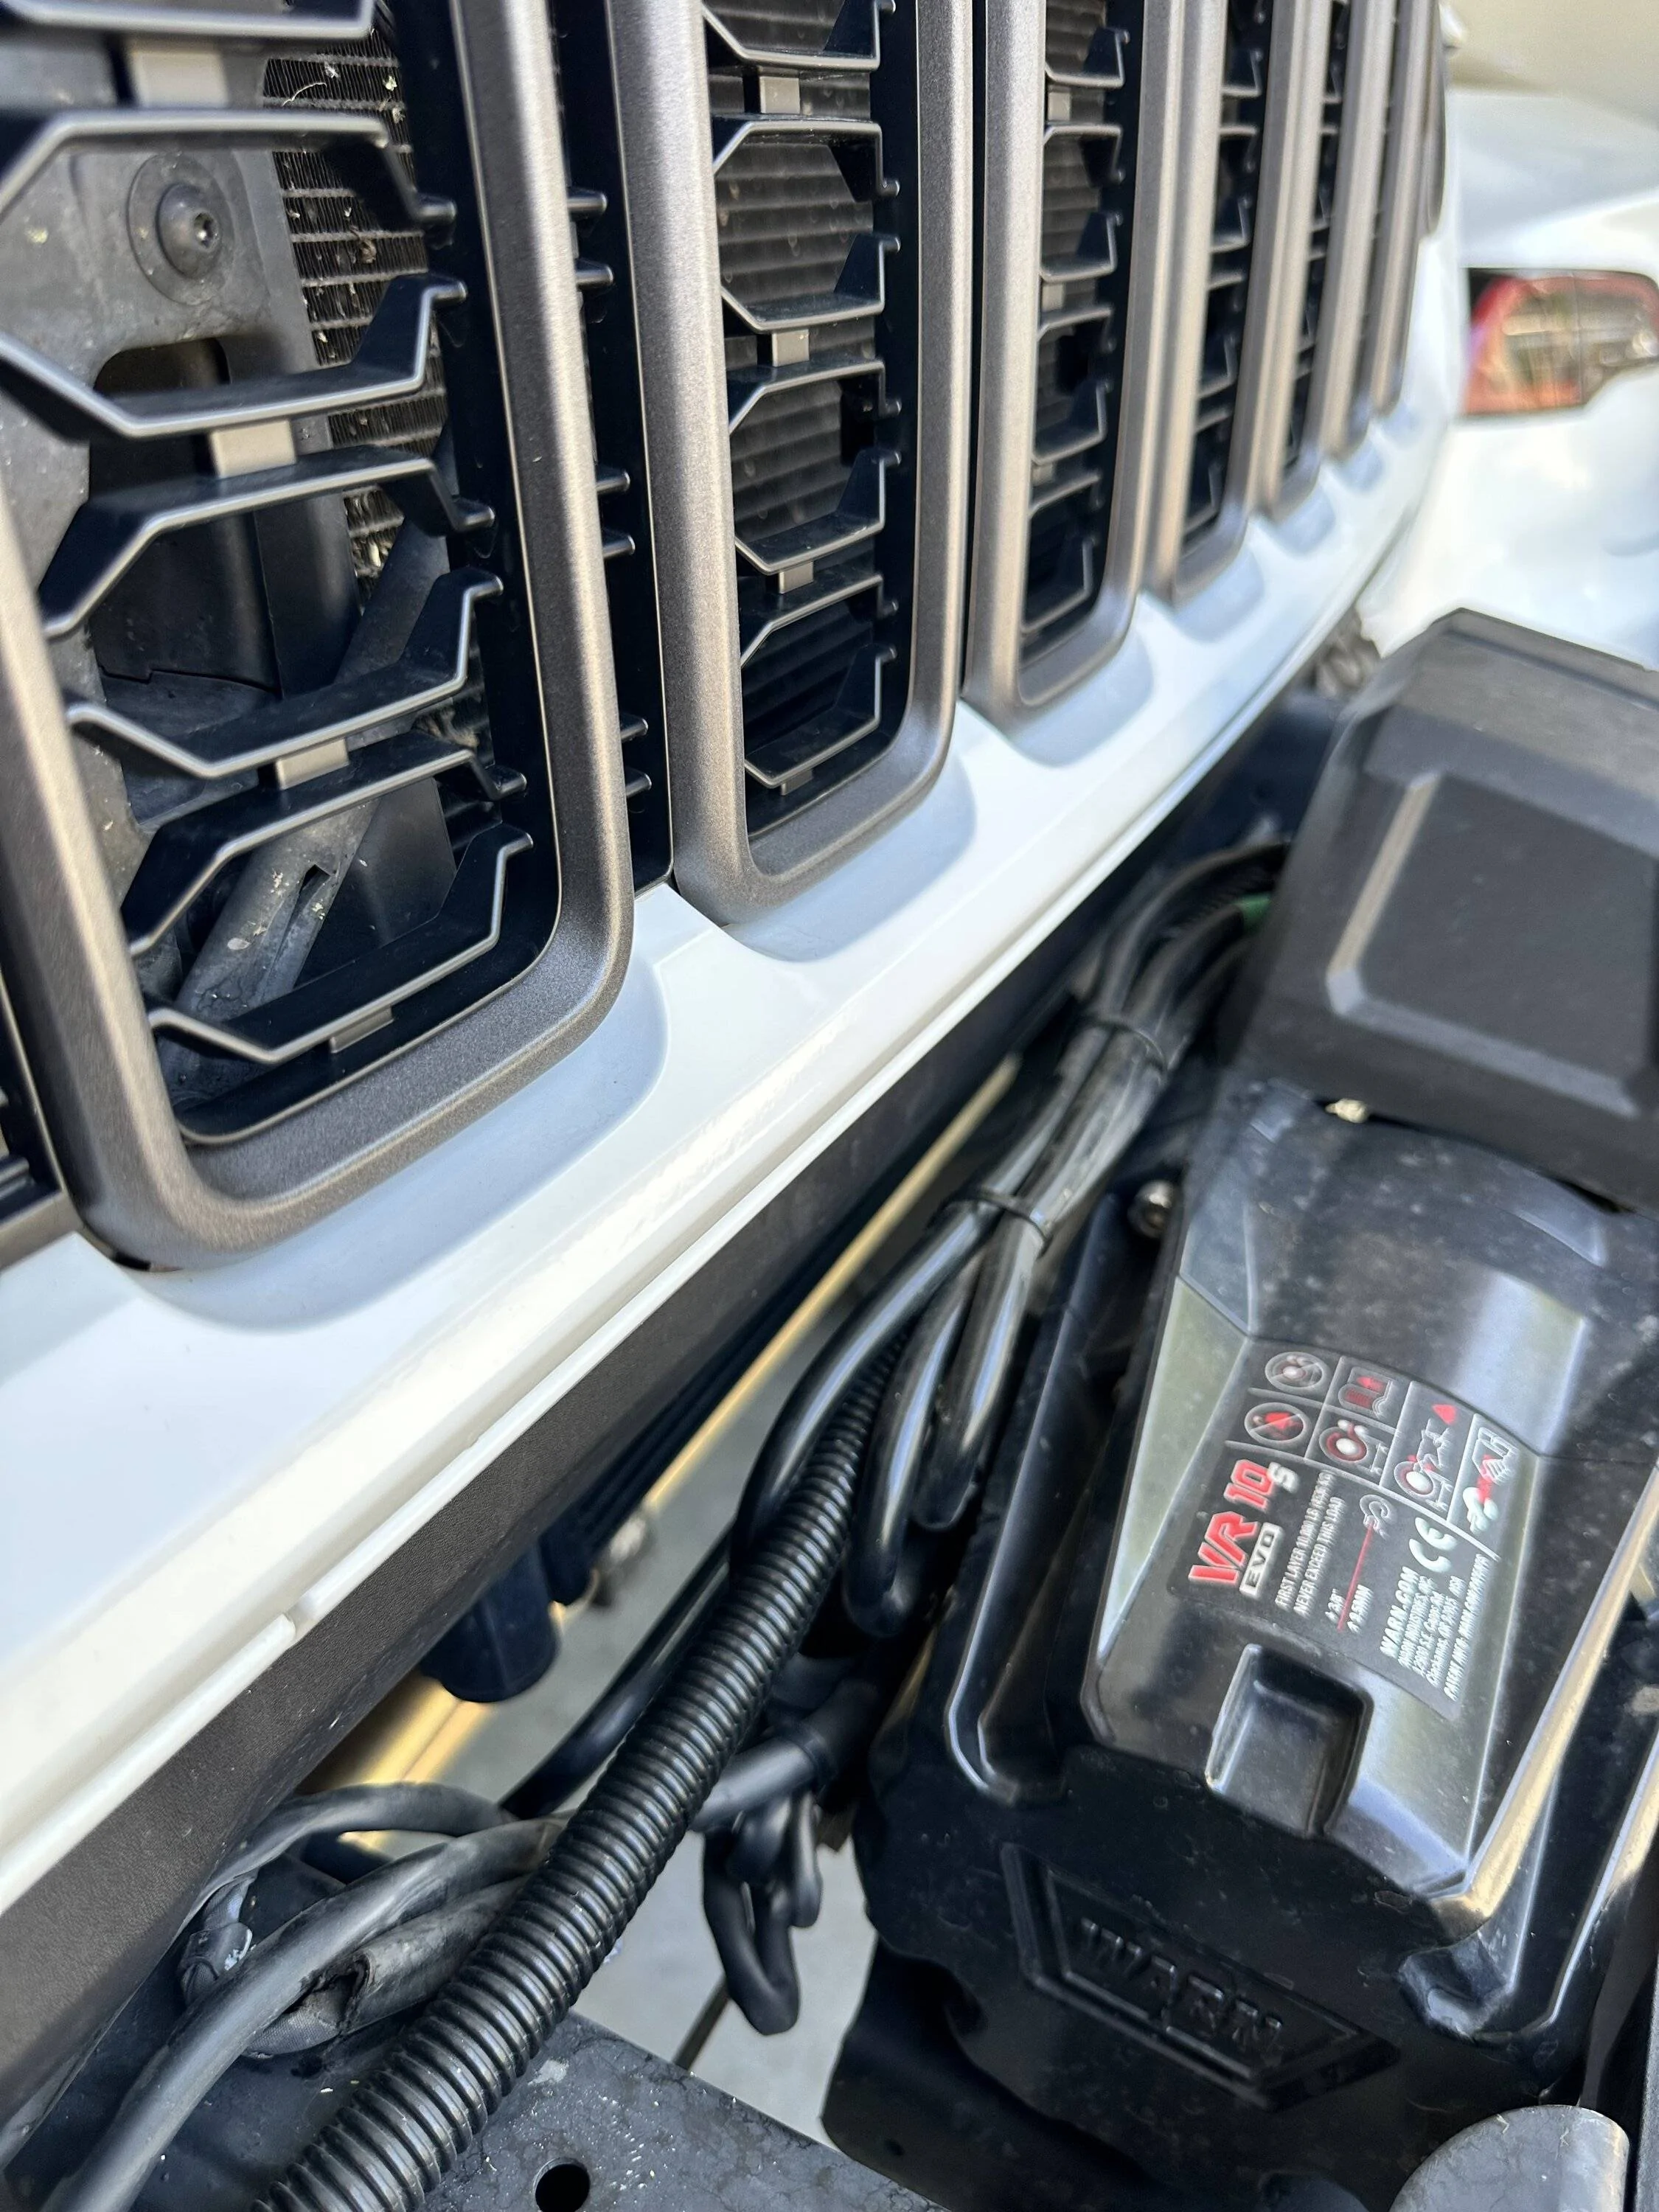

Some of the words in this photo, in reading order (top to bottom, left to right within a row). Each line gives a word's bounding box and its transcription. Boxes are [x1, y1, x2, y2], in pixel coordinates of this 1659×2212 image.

[1324, 1496, 1346, 1524] LOAD
[1188, 1511, 1260, 1585] VR
[1316, 1520, 1338, 1547] THIS
[1409, 1517, 1459, 1573] CE
[1245, 1530, 1275, 1588] EVO
[1284, 1547, 1307, 1582] LAYER
[1304, 1543, 1328, 1580] EXCEED
[1275, 1576, 1296, 1612] FIRST
[1293, 1579, 1315, 1618] NEVER
[1380, 1566, 1420, 1658] WARN.COM
